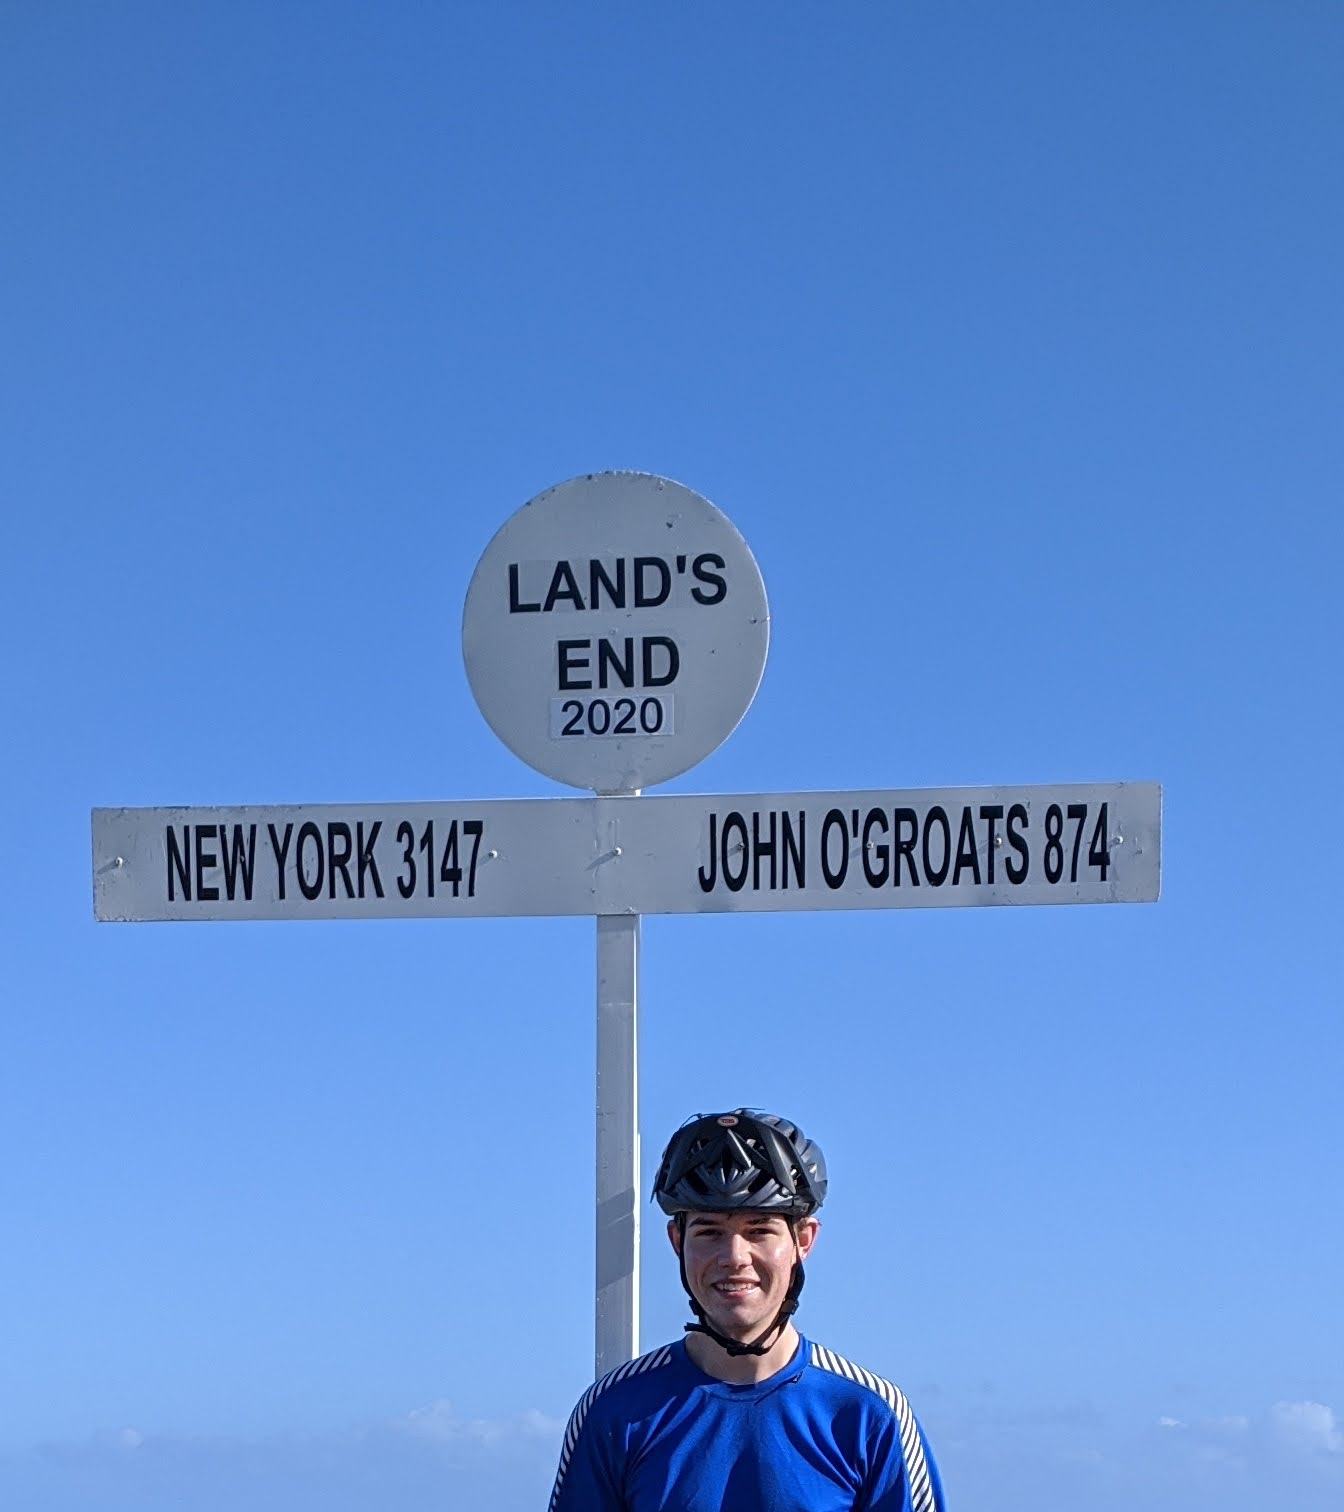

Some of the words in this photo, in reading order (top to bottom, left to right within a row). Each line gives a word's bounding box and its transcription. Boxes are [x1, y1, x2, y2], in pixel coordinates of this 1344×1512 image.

[508, 553, 728, 614] LAND'S
[557, 636, 680, 691] END
[561, 697, 663, 737] 2020
[166, 823, 257, 902] NEW
[267, 821, 385, 901] YORK
[396, 819, 484, 899] 3147
[698, 810, 806, 893] JOHN
[820, 803, 1030, 890] O'GROATS
[1043, 802, 1111, 885] 874
